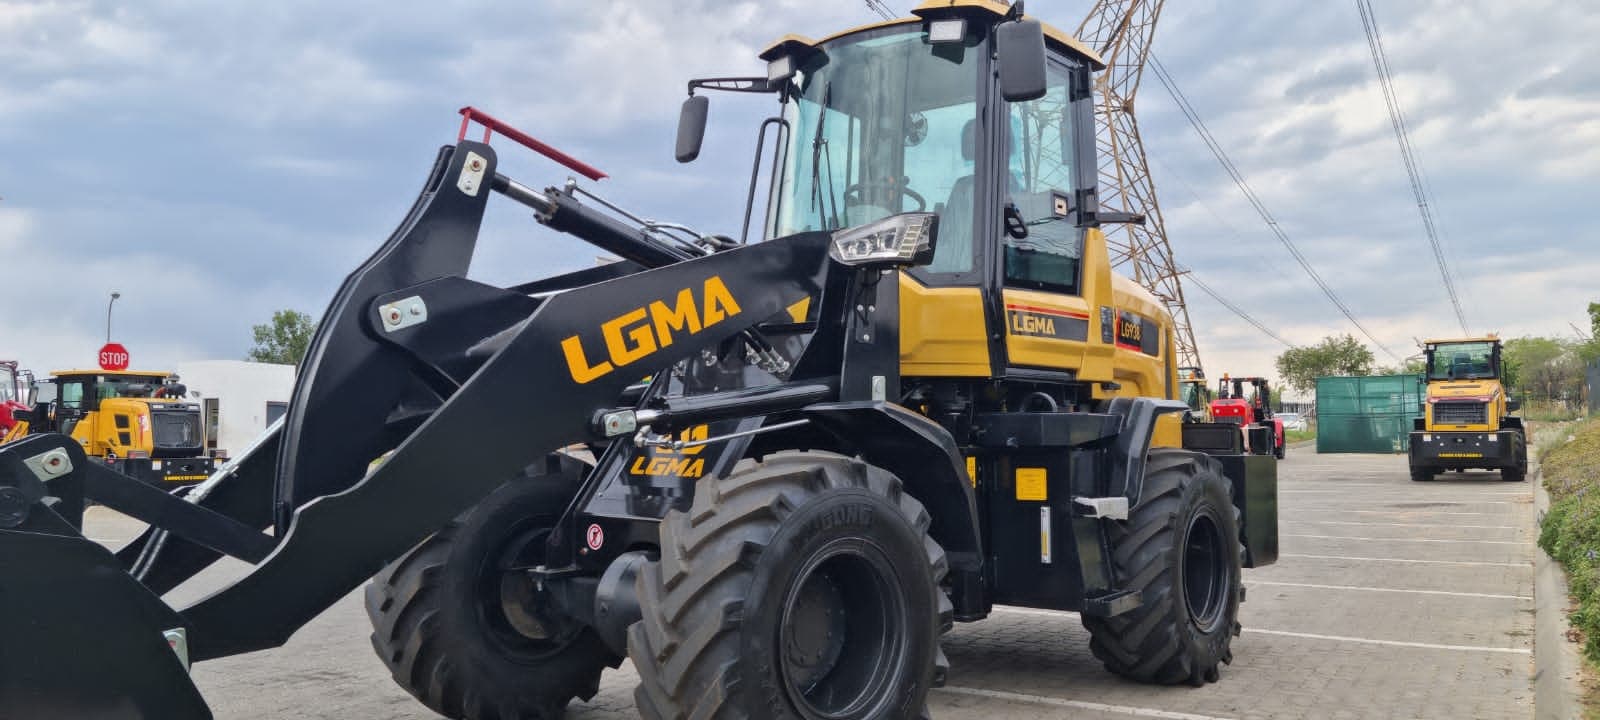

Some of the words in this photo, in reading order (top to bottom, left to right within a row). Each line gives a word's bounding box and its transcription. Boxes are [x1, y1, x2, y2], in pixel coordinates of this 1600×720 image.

[561, 275, 742, 384] LGMA
[1013, 315, 1056, 335] LGMA
[101, 351, 128, 366] STOP
[630, 456, 705, 478] LGMA
